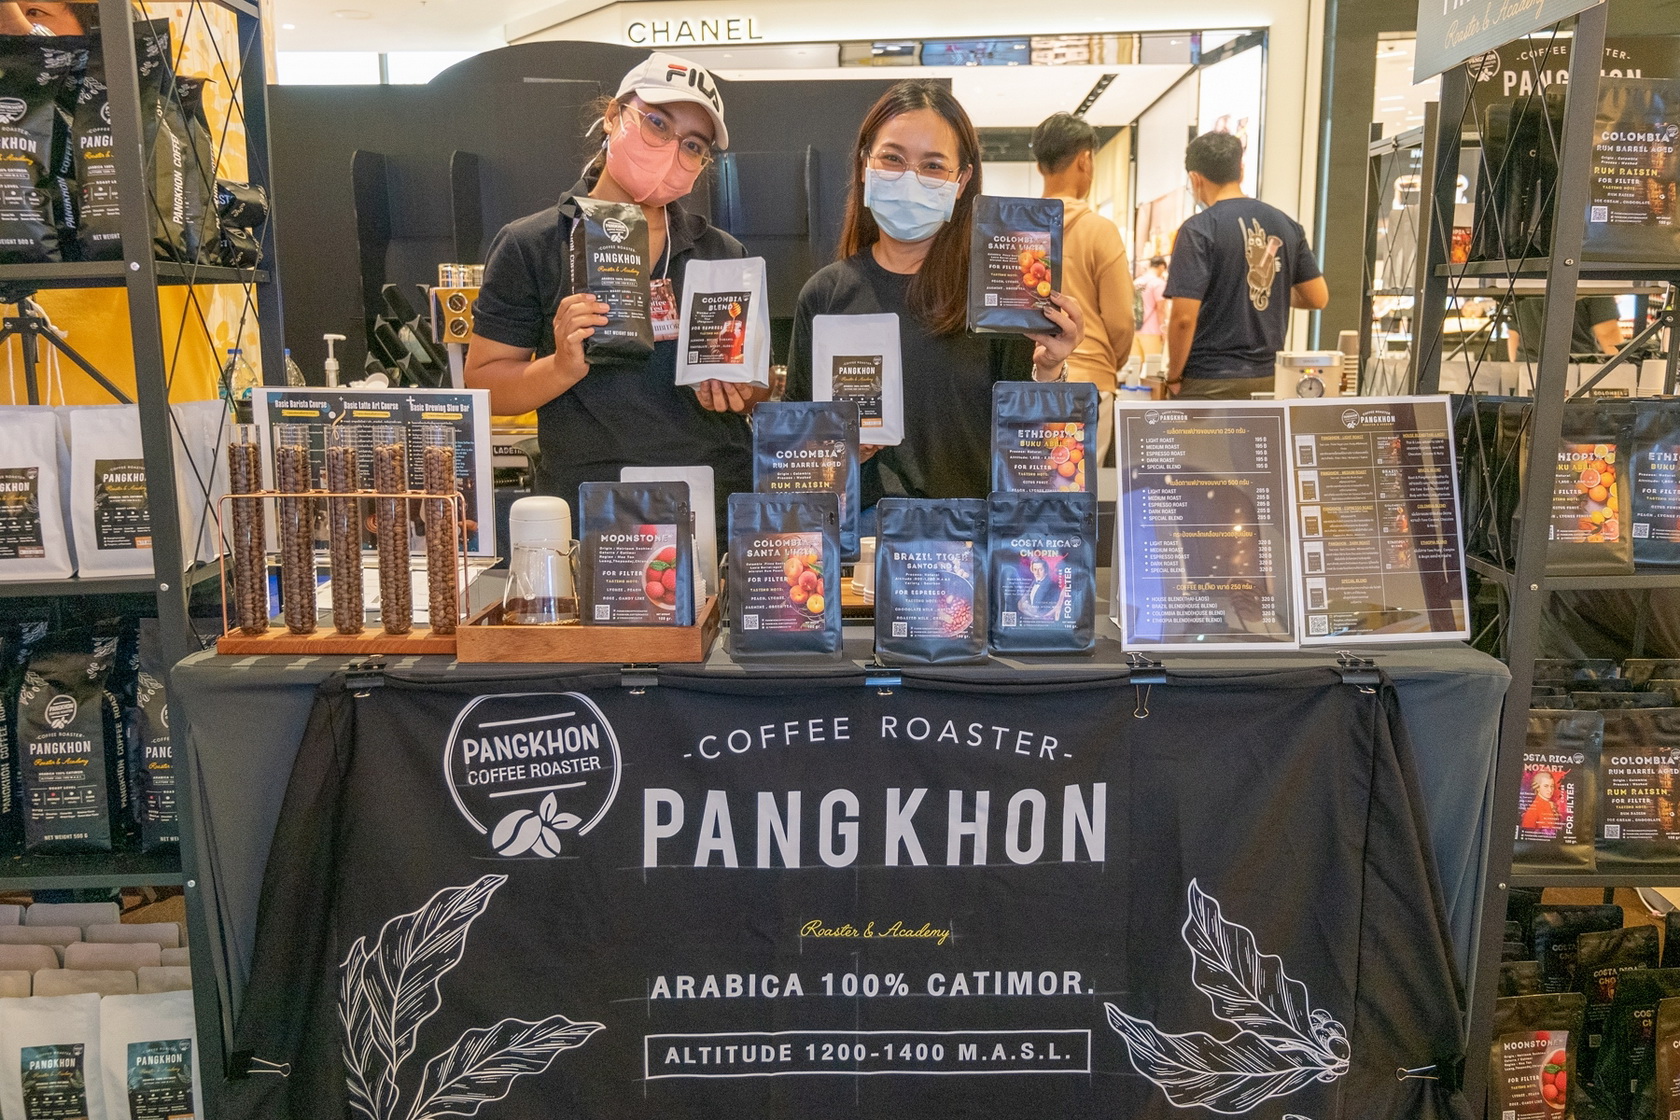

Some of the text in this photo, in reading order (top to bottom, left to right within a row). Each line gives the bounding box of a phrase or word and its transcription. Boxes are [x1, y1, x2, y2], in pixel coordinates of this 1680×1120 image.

[628, 18, 763, 44] CHANEL
[80, 134, 114, 149] PANG
[1601, 131, 1670, 143] COLOMBIA
[1616, 145, 1648, 153] BARREL
[1594, 167, 1615, 175] RUM
[172, 170, 183, 225] PANGKHON
[593, 252, 641, 265] PANGKHON
[702, 296, 743, 304] COLOMBIA
[838, 367, 876, 375] PANGKHON
[274, 400, 289, 408] Basic
[343, 401, 358, 409] Basic
[1360, 415, 1395, 424] PANGKHON
[776, 450, 838, 459] COLOMBIA
[103, 472, 147, 483] PANGKHO
[1011, 539, 1044, 547] COSTA
[747, 549, 780, 557] SANTA
[894, 553, 932, 561] BRAZIL
[1020, 549, 1059, 557] CHOPIN
[1064, 567, 1072, 619] FOR FILTER
[462, 723, 600, 764] PANGKHON
[683, 716, 1073, 761] -COFFEE ROASTER-
[29, 740, 91, 755] PANGKHON
[1549, 755, 1574, 764] RICA
[1611, 756, 1675, 765] COLOMBIA
[468, 755, 601, 786] COFFEE ROASTER
[1524, 763, 1563, 772] MOZART
[1566, 783, 1574, 834] FOR FILTER
[643, 782, 1107, 869] PANGKHON
[800, 919, 950, 946] Roaster & Academy
[650, 970, 1095, 1000] ARABICA 100% CATIMOR.
[664, 1041, 1072, 1065] ALTITUDE 1200-1400 M.A.S.L.
[29, 1057, 76, 1070] PANGKHON
[136, 1053, 183, 1066] PANGKHON
